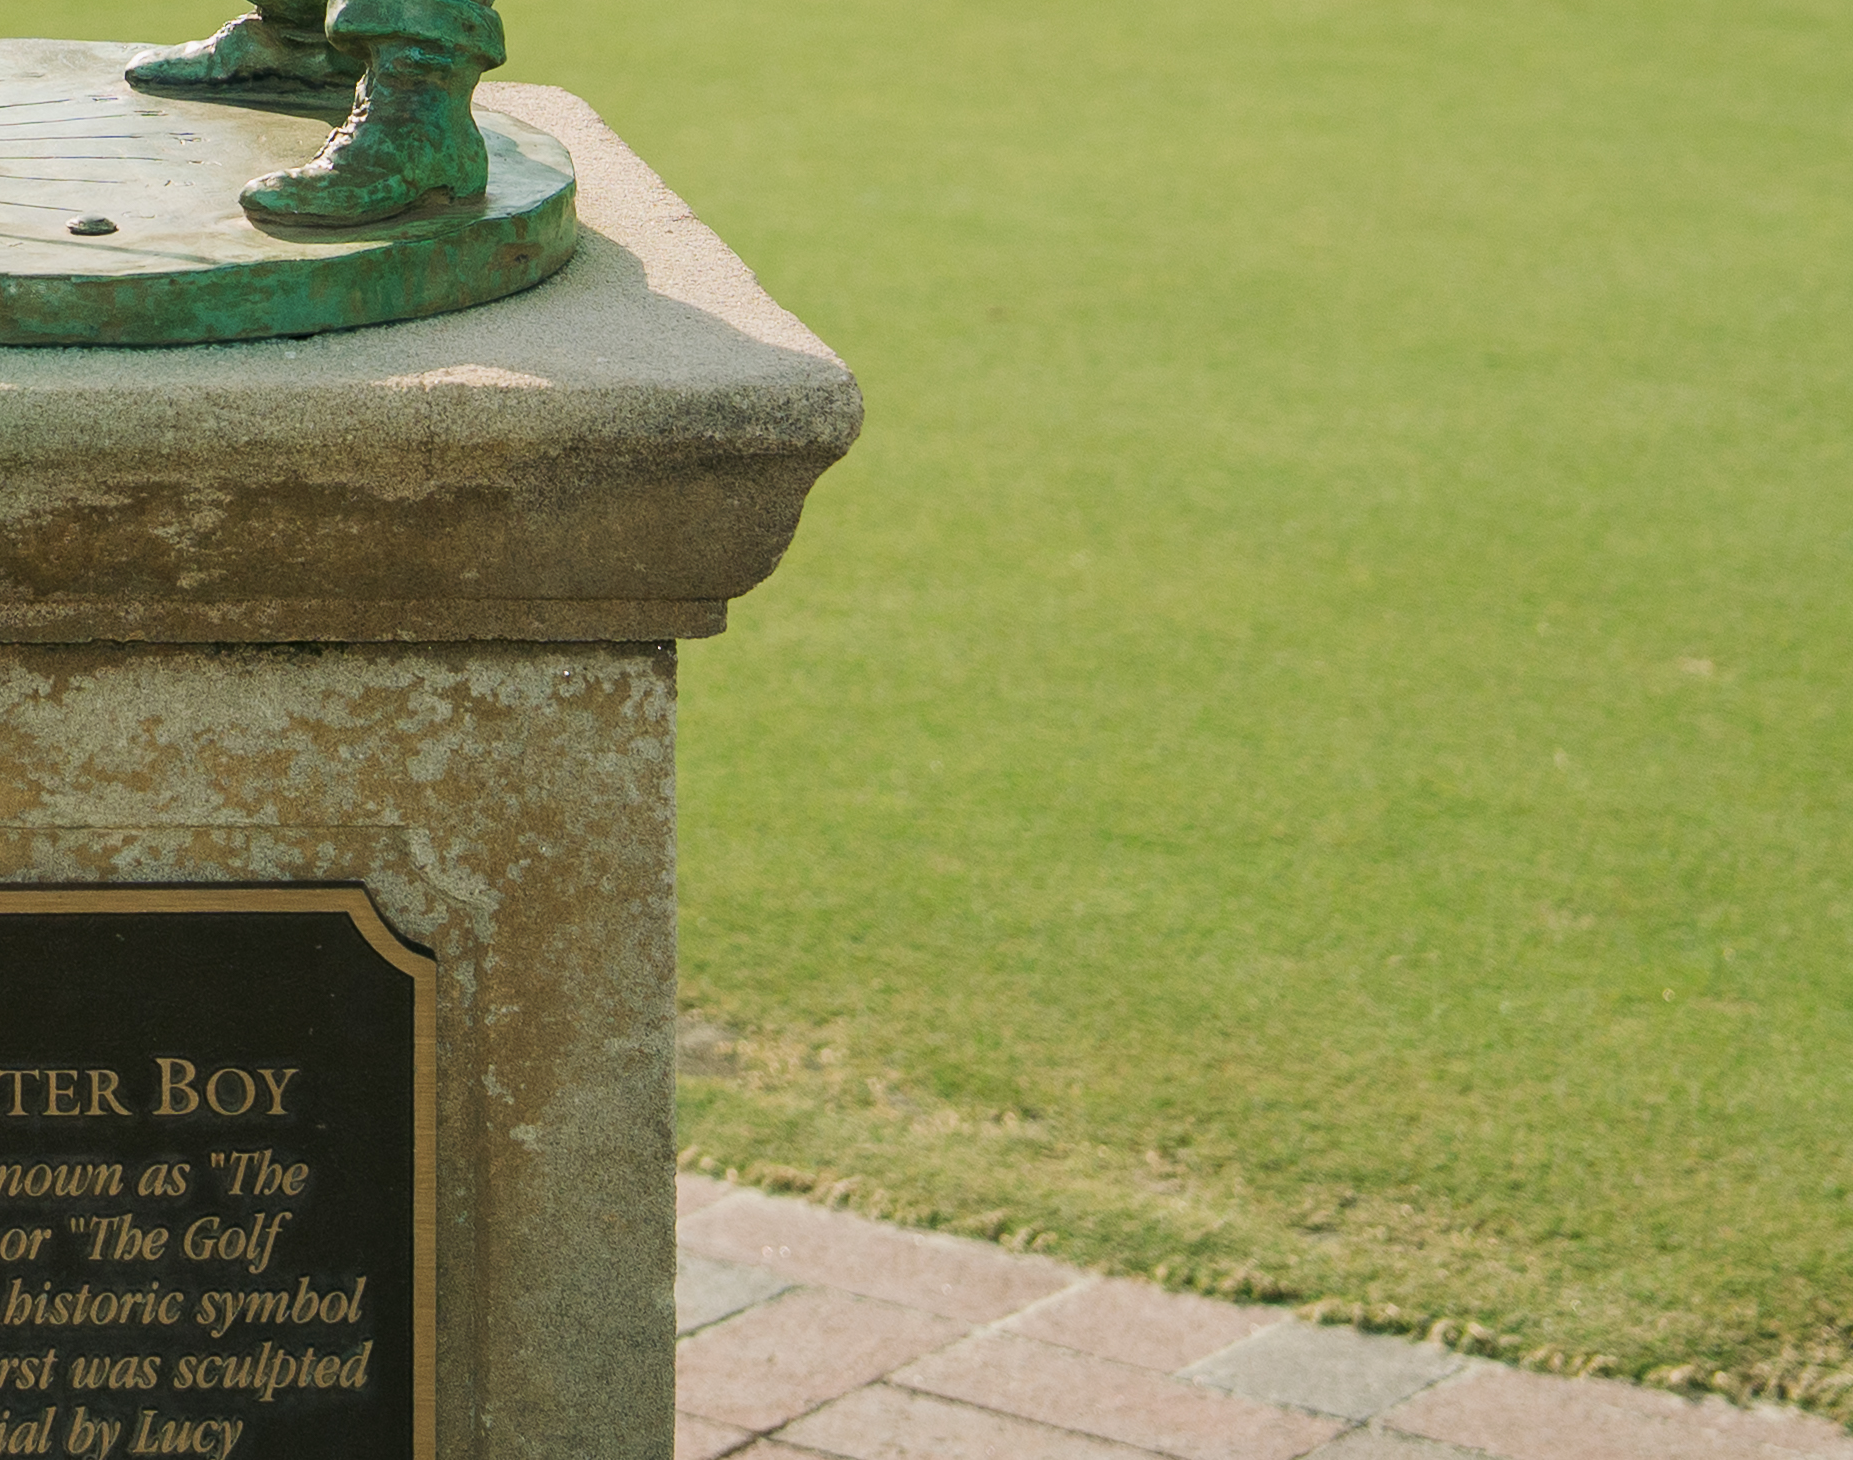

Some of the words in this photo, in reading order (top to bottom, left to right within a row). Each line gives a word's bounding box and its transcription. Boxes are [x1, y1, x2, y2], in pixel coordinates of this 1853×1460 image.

[138, 1164, 190, 1196] as
[0, 1229, 51, 1260] or
[184, 1212, 292, 1273] Golf
[4, 1279, 183, 1325] historic
[197, 1277, 366, 1338] symbol
[72, 1357, 159, 1389] was
[174, 1341, 372, 1401] sculpted
[70, 1408, 120, 1460] by
[133, 1411, 243, 1460] Lucy
